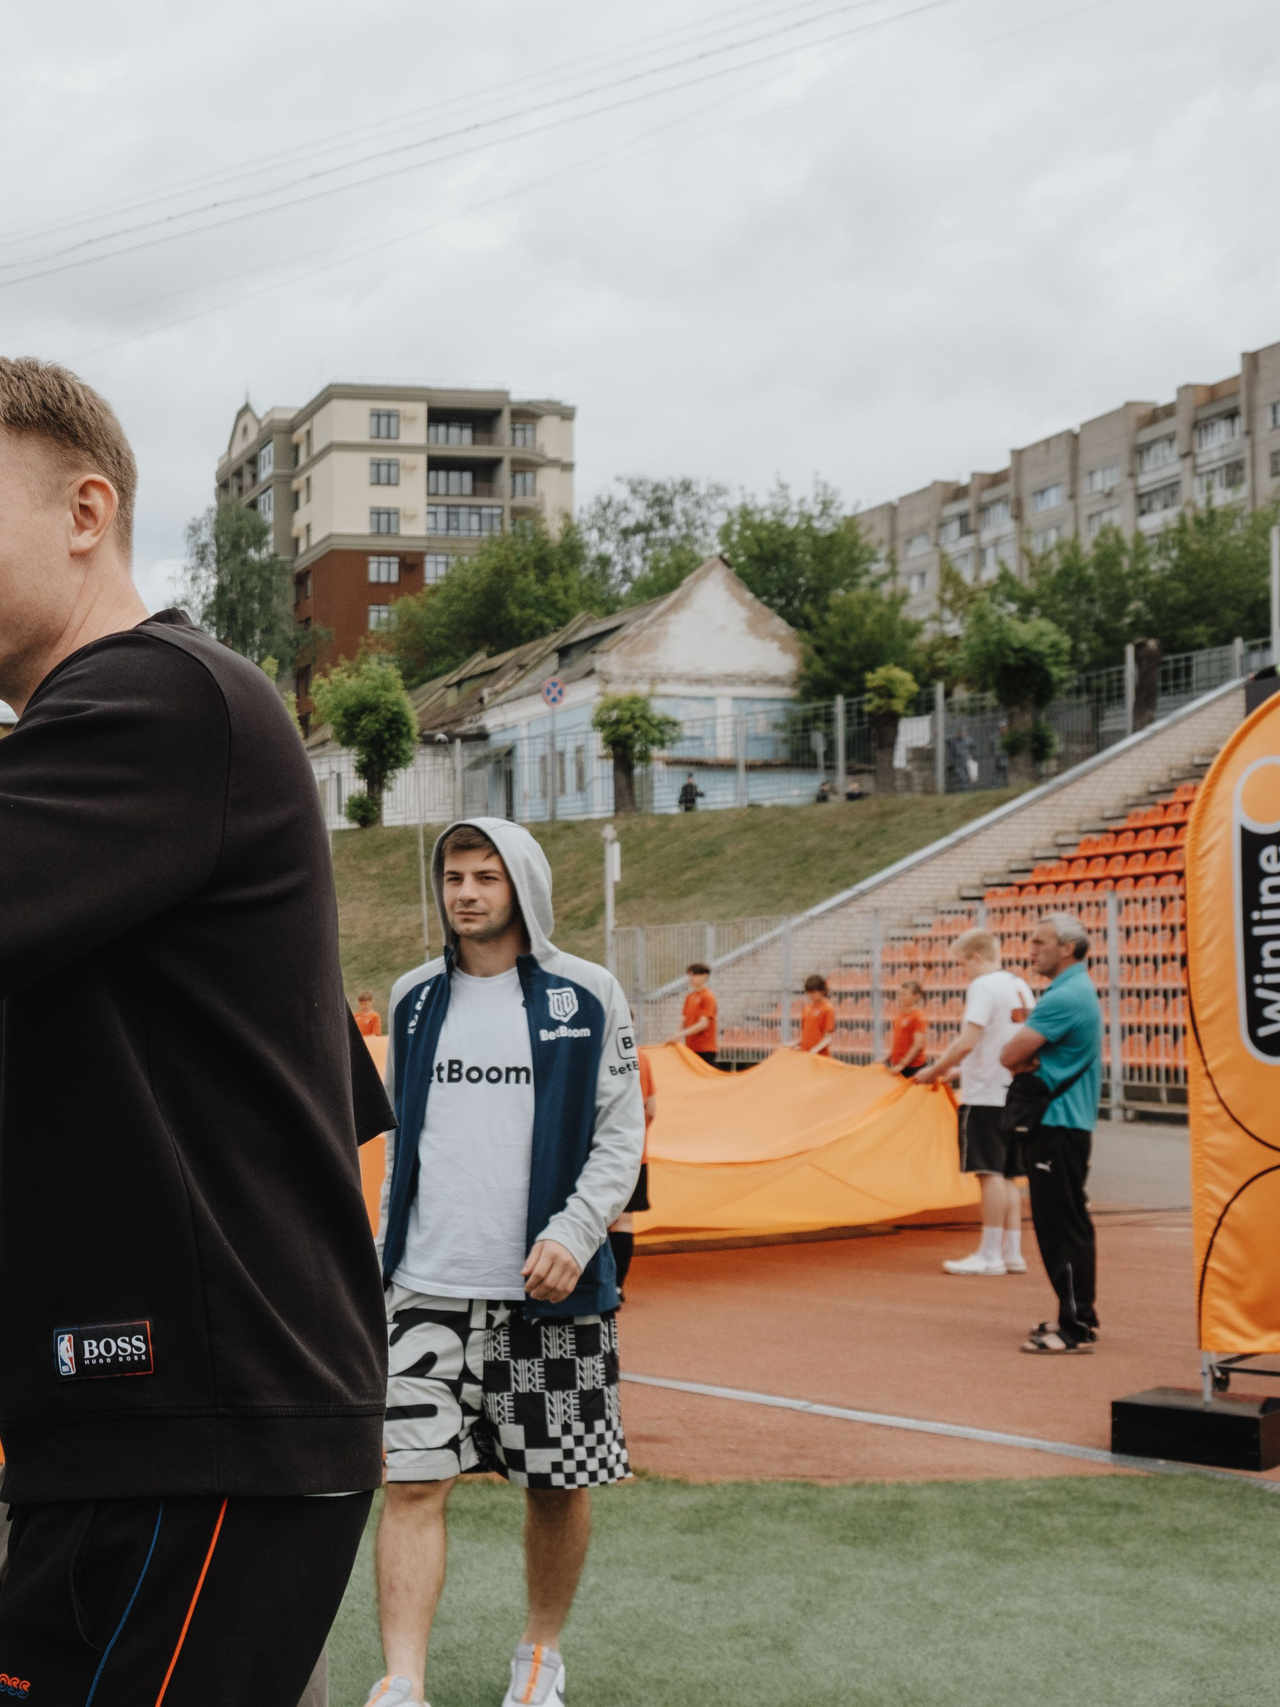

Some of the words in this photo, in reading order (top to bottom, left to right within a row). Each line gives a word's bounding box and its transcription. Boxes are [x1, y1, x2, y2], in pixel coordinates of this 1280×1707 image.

[1250, 844, 1280, 1038] Winline
[431, 1059, 531, 1085] tBoom
[541, 1325, 575, 1338] NIKE
[83, 1335, 147, 1359] BOSS
[542, 1337, 576, 1349] NIKE
[543, 1347, 577, 1359] NIKE
[84, 1358, 112, 1366] HUGO
[118, 1355, 147, 1363] BOSS
[510, 1359, 544, 1371] NIKE
[576, 1356, 605, 1368] NIKE
[510, 1370, 545, 1382] NIKE
[576, 1367, 606, 1379] NIKE
[512, 1381, 546, 1393] NIKE
[577, 1378, 606, 1390] NIKE
[545, 1391, 579, 1403] NIKE
[545, 1402, 580, 1414] NIKE
[546, 1413, 581, 1425] NIKE
